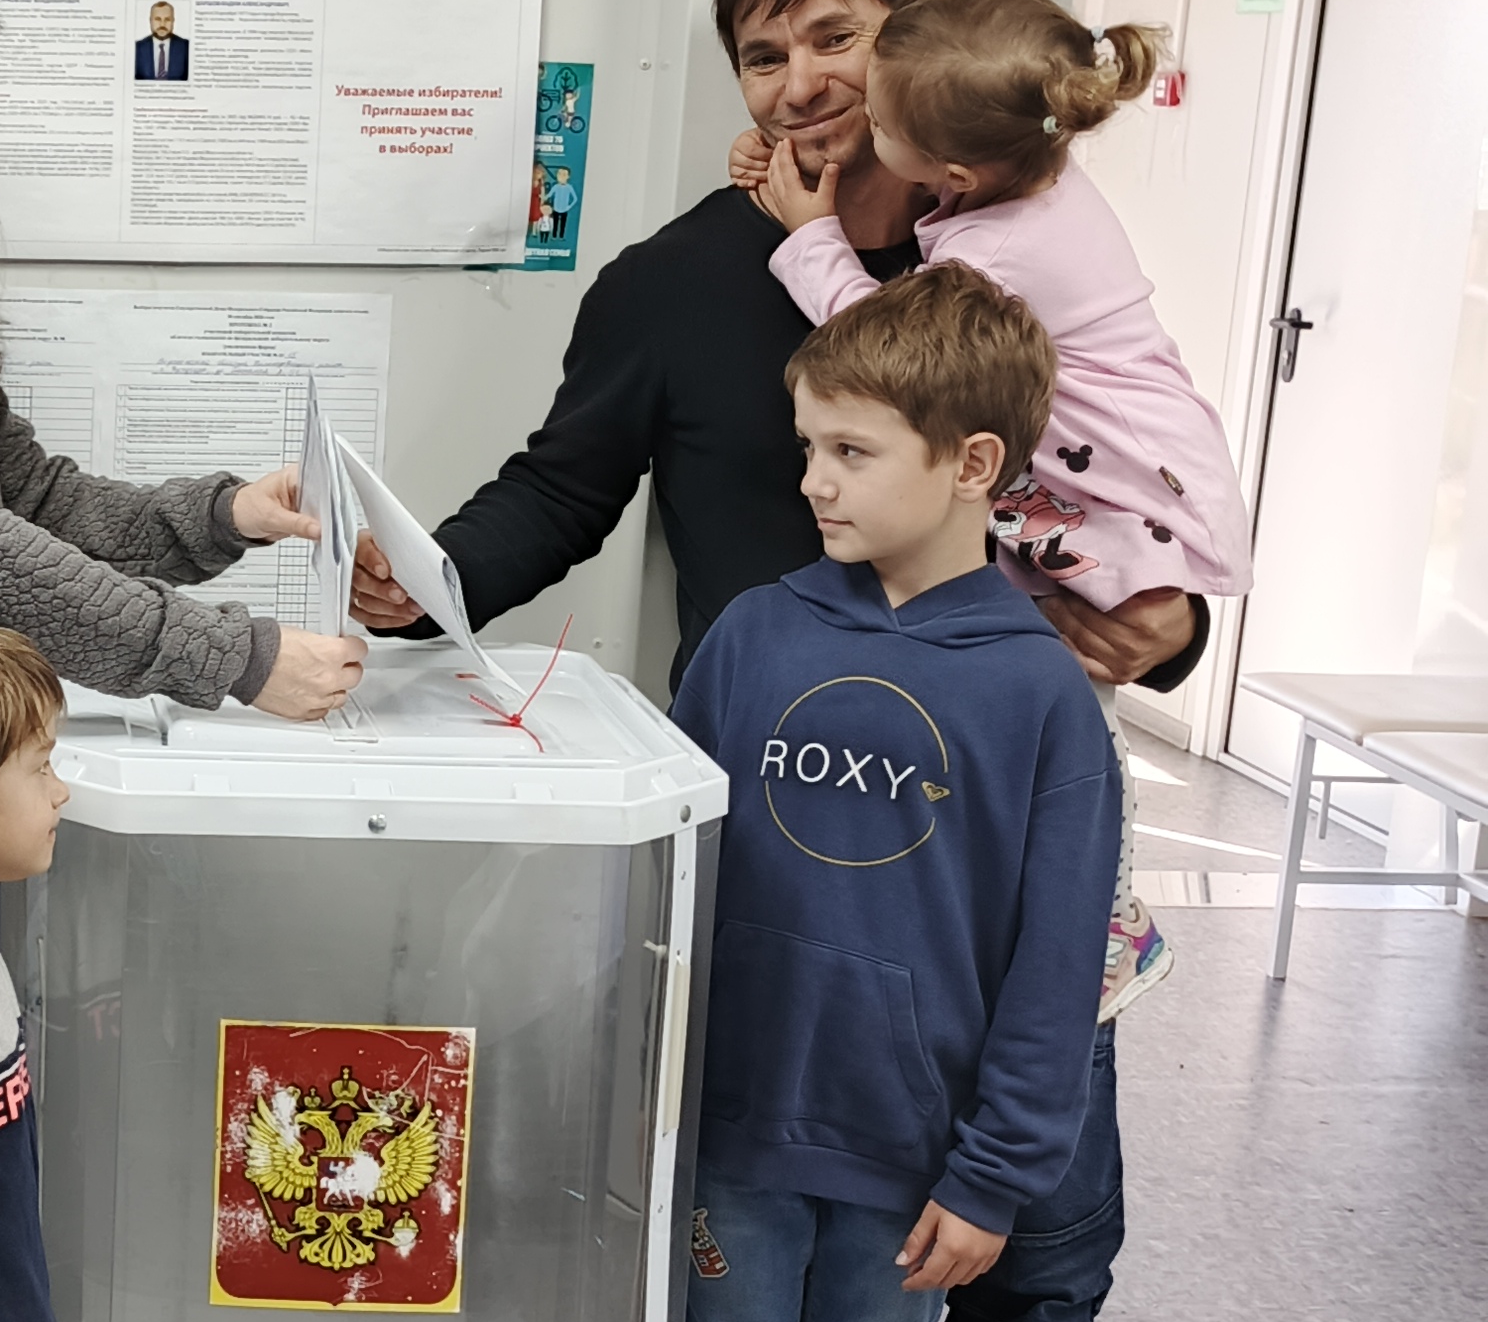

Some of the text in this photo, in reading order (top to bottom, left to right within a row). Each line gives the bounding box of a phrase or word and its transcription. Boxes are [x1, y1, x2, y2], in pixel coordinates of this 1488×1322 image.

[335, 84, 503, 100] Уважаемые избиратели!
[361, 104, 474, 120] Приглашаем вас
[360, 125, 473, 139] принять участие
[378, 143, 453, 156] в выборах!
[760, 740, 916, 799] ROXY
